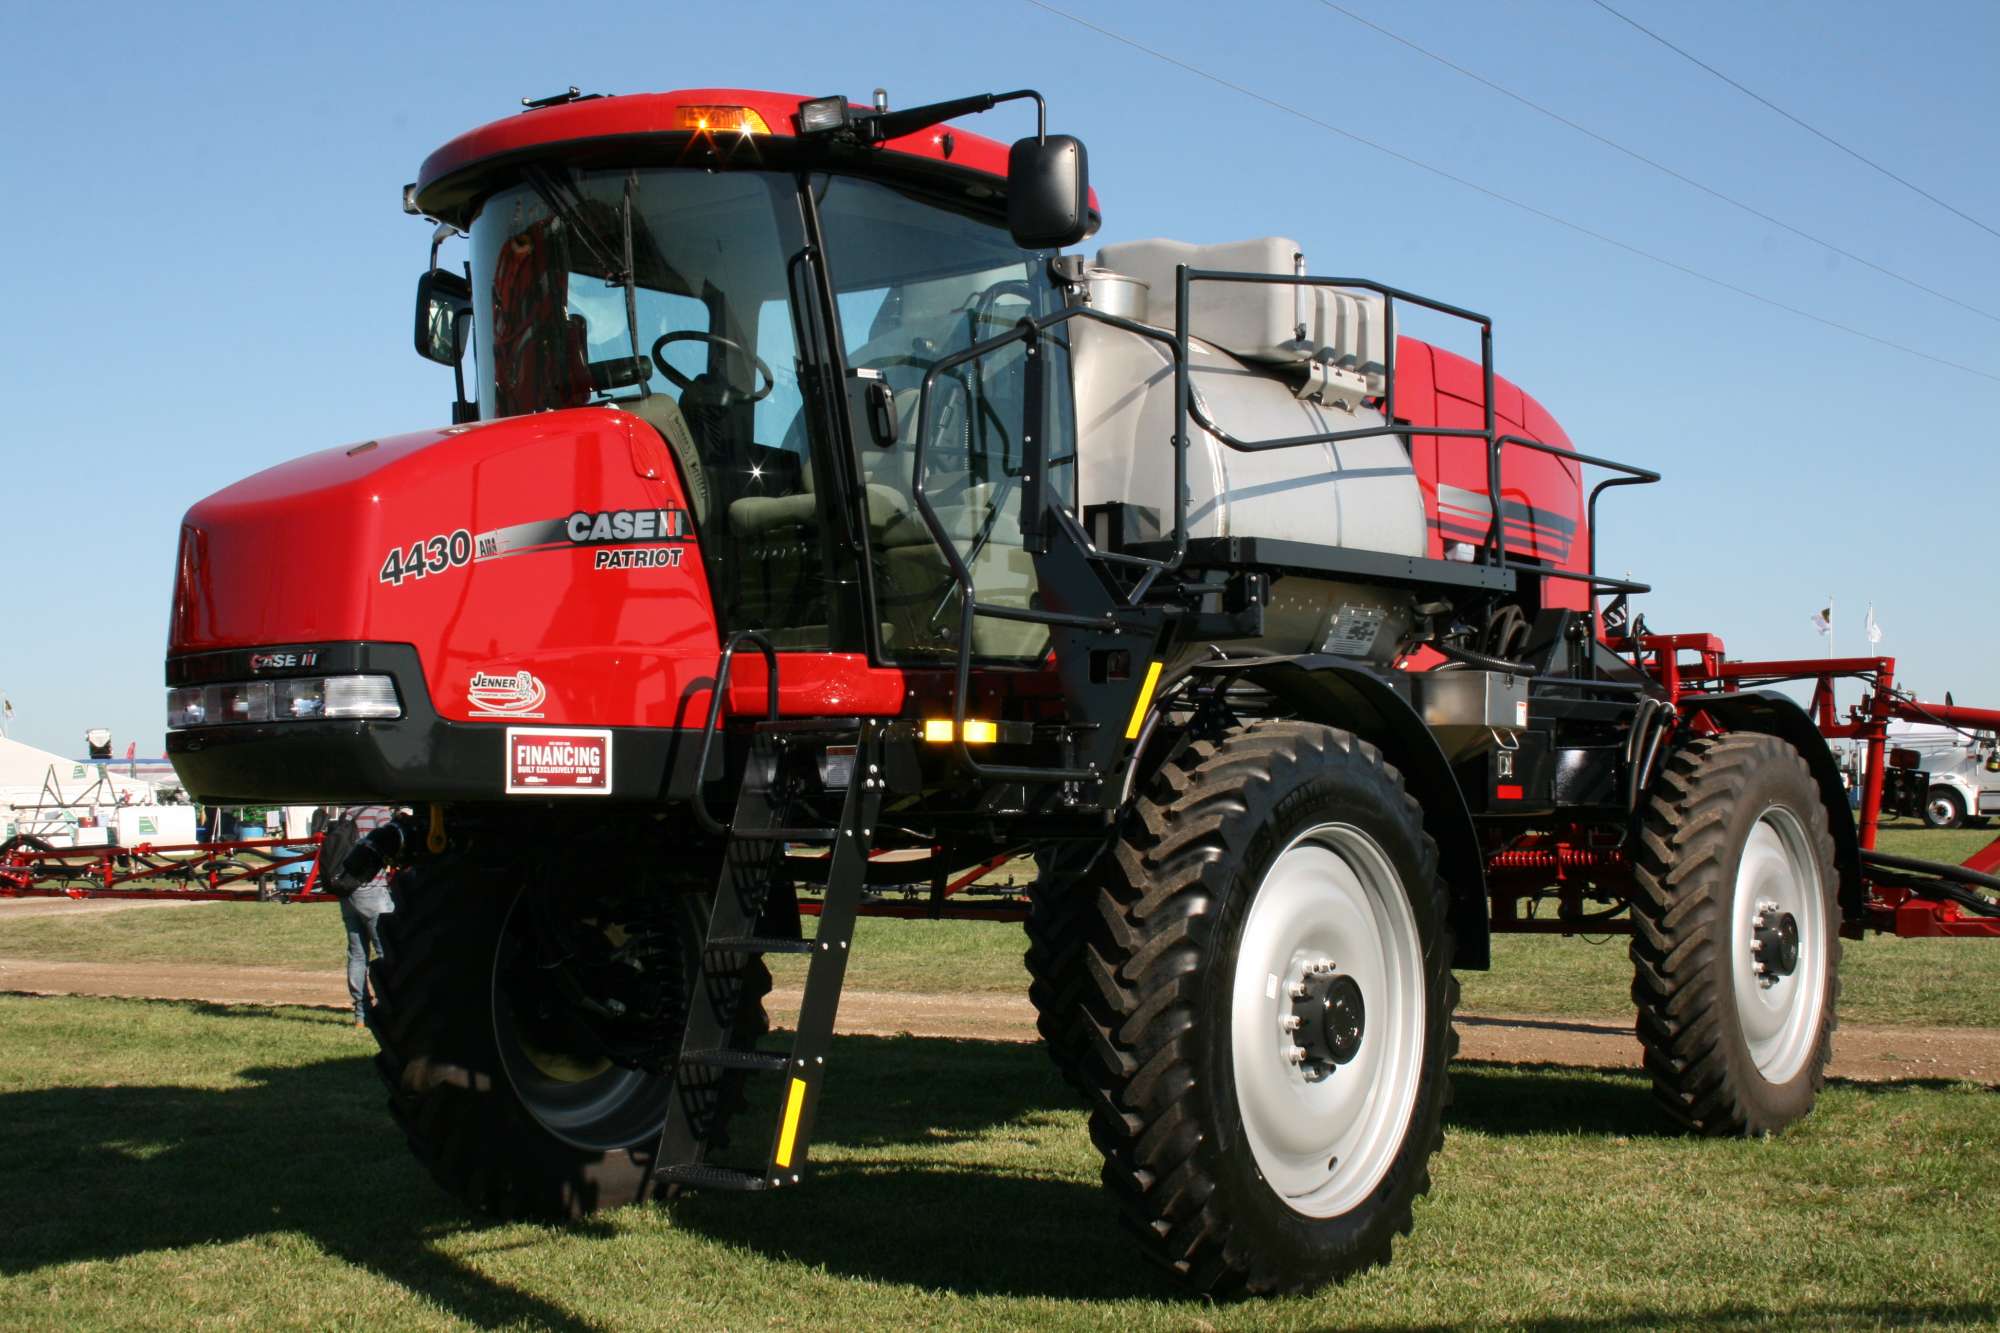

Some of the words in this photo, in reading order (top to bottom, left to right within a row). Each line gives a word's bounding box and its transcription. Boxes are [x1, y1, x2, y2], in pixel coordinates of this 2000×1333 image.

[567, 511, 655, 541] CASE
[380, 529, 472, 586] 4430
[595, 548, 683, 570] PATRIOT
[473, 673, 516, 688] JENNER
[517, 745, 600, 766] FINANCING
[536, 766, 574, 774] EXCLUSIVELY
[576, 766, 587, 774] FOR
[588, 767, 600, 775] YOU
